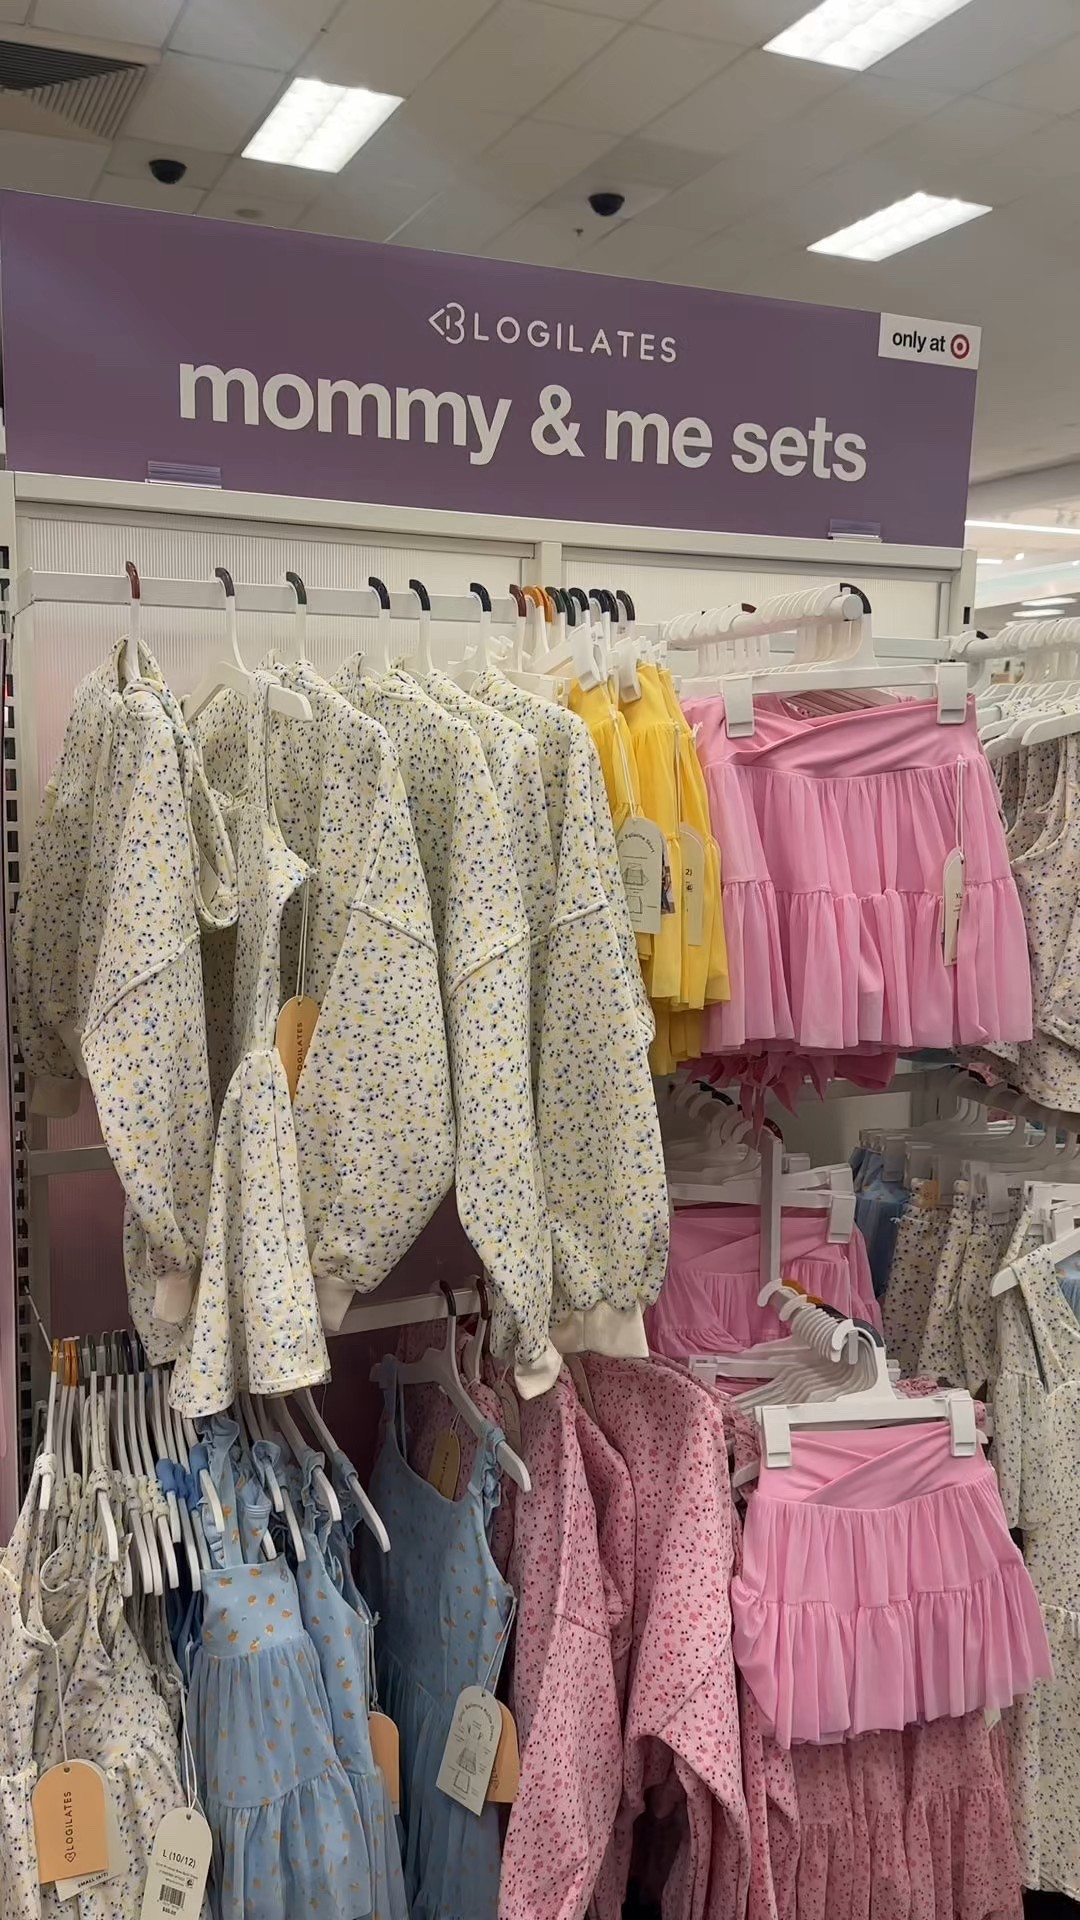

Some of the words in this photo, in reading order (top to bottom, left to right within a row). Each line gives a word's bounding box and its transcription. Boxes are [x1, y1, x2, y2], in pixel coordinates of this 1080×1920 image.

[892, 330, 927, 353] only
[929, 335, 946, 352] at
[179, 362, 511, 466] mommy
[530, 384, 586, 458] &
[605, 408, 713, 469] me
[731, 416, 867, 482] sets
[162, 1849, 167, 1858] L
[168, 1851, 196, 1869] (10/12)
